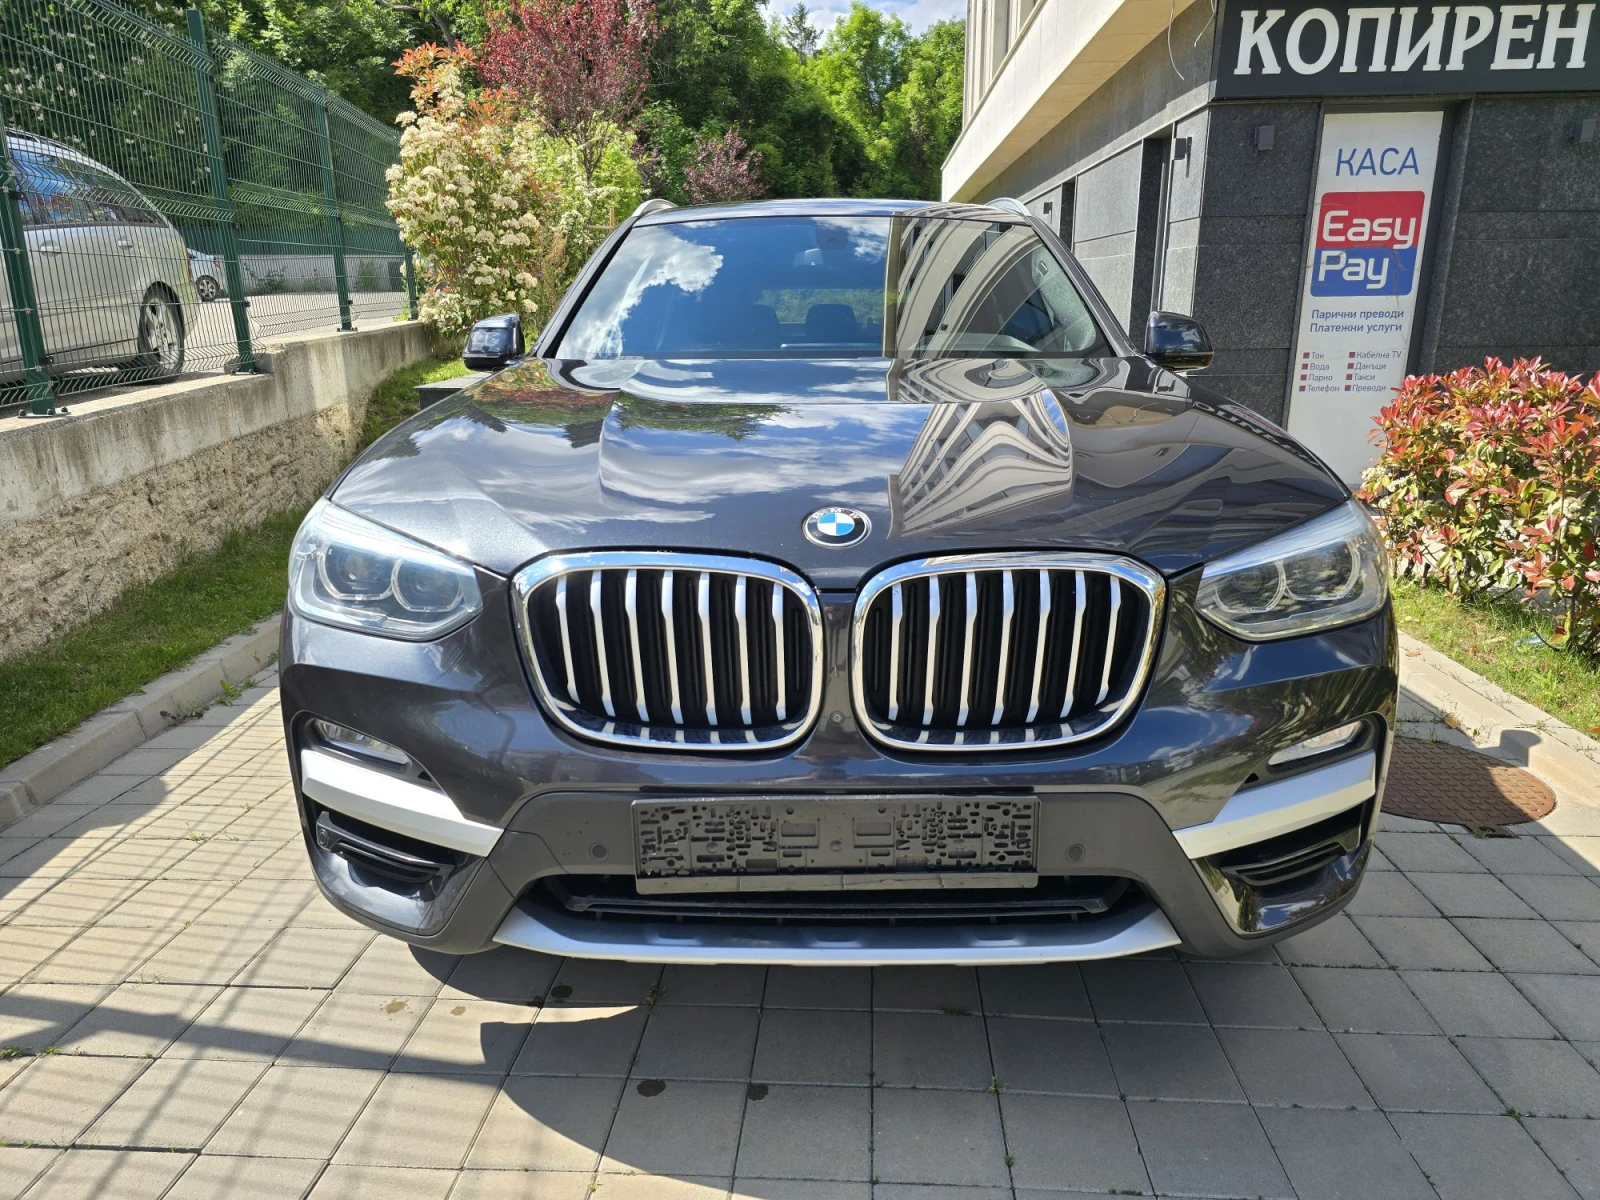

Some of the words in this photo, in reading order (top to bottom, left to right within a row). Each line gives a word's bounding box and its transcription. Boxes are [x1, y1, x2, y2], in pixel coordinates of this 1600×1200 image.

[1234, 4, 1596, 75] КОПИРЕН
[1335, 147, 1420, 176] КАСА
[1322, 210, 1417, 249] Easy
[1318, 250, 1390, 290] Pay
[1311, 309, 1357, 320] Парични
[1359, 310, 1405, 320] преводи
[1310, 323, 1364, 333] Платежни
[1366, 323, 1403, 334] услуги
[1356, 351, 1390, 359] Кабелна
[1309, 363, 1330, 371] Вода
[1354, 362, 1387, 371] Данъци
[1308, 374, 1333, 382] Парно
[1353, 373, 1376, 381] Такси
[1307, 384, 1340, 393] Телефон
[1351, 384, 1387, 393] Преводи
